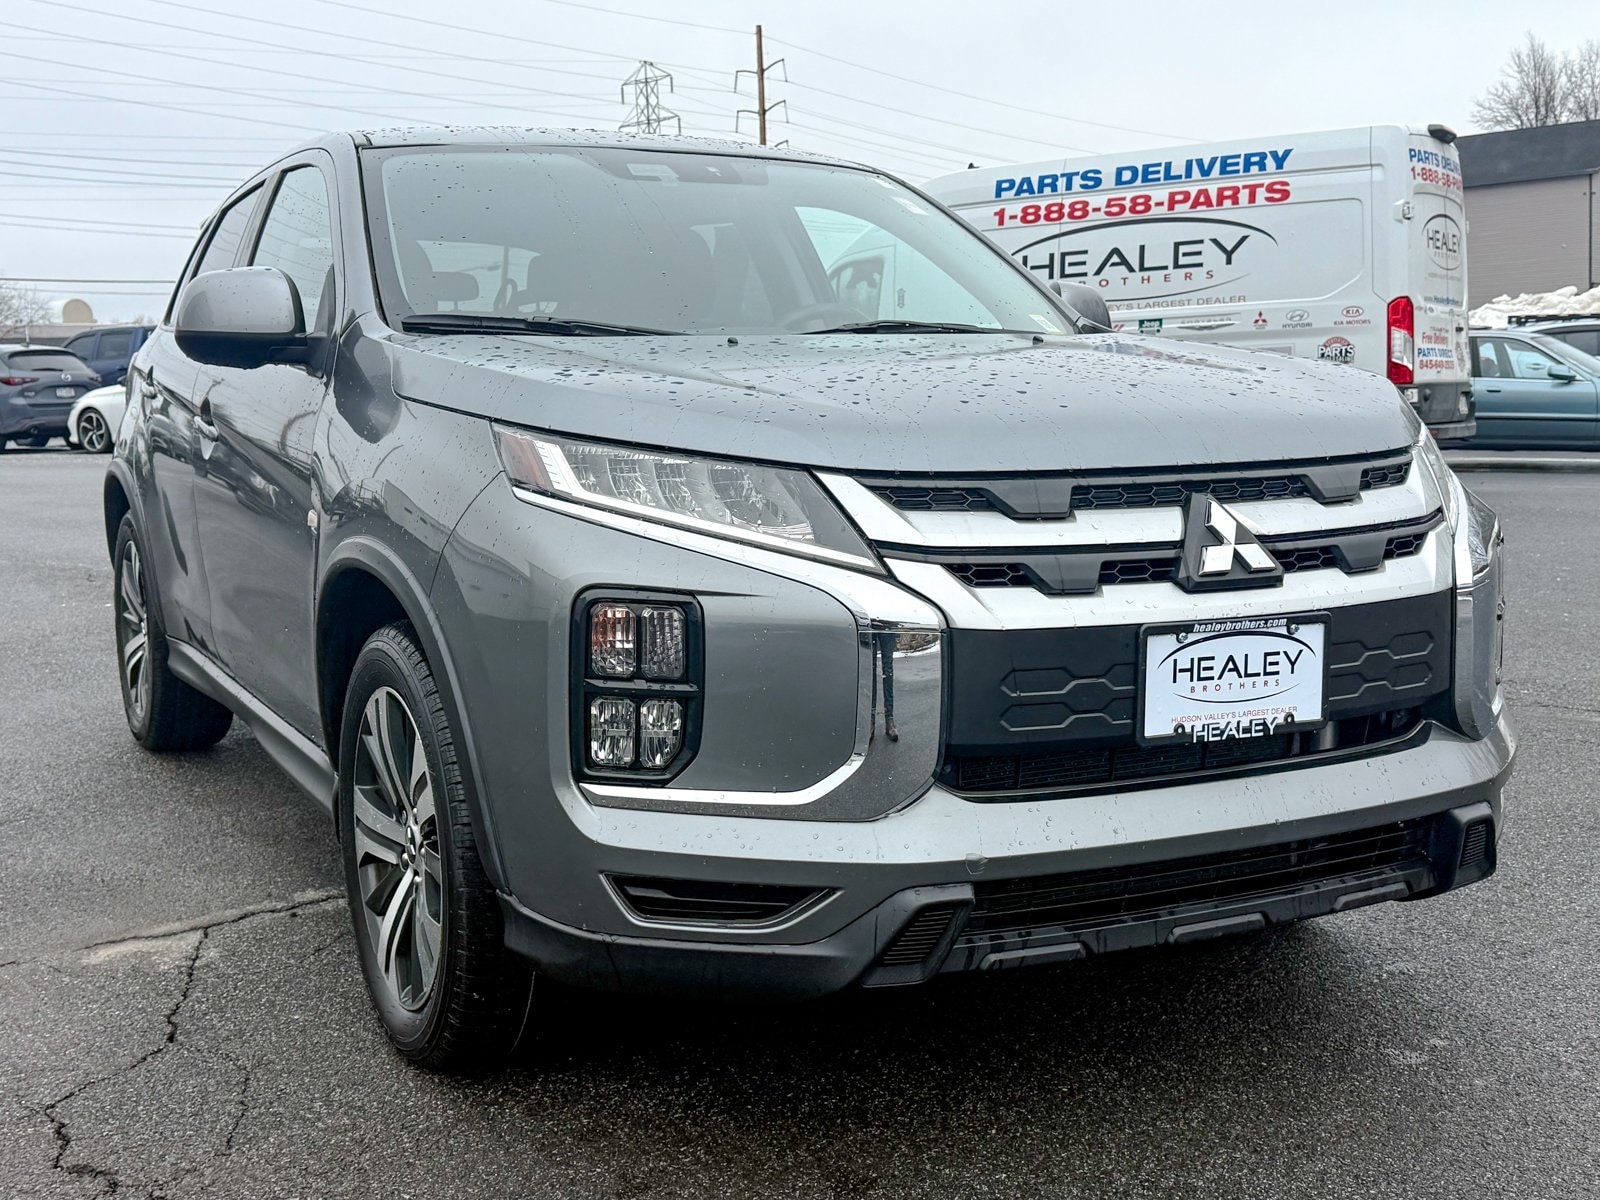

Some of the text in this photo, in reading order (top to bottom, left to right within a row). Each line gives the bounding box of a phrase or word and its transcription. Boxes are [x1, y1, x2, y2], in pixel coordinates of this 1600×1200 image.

[1408, 148, 1440, 168] PARTS
[995, 148, 1294, 199] PARTS DELIVERY
[993, 180, 1291, 227] 1-888-58-PARTS
[1022, 234, 1251, 280] HEALEY
[1137, 299, 1193, 310] LARGEST
[1196, 295, 1247, 306] DEALER
[1142, 319, 1160, 329] Jeep
[1318, 344, 1354, 359] PARTS
[1417, 348, 1438, 358] PARTS
[1193, 618, 1287, 633] healeybrothers.com
[1172, 649, 1304, 683] HEALEY
[1190, 678, 1280, 694] BROTHERS
[1172, 705, 1298, 724] HUDSON VALLEY'S LARGEST DEALER
[1192, 717, 1278, 743] HEALEY
